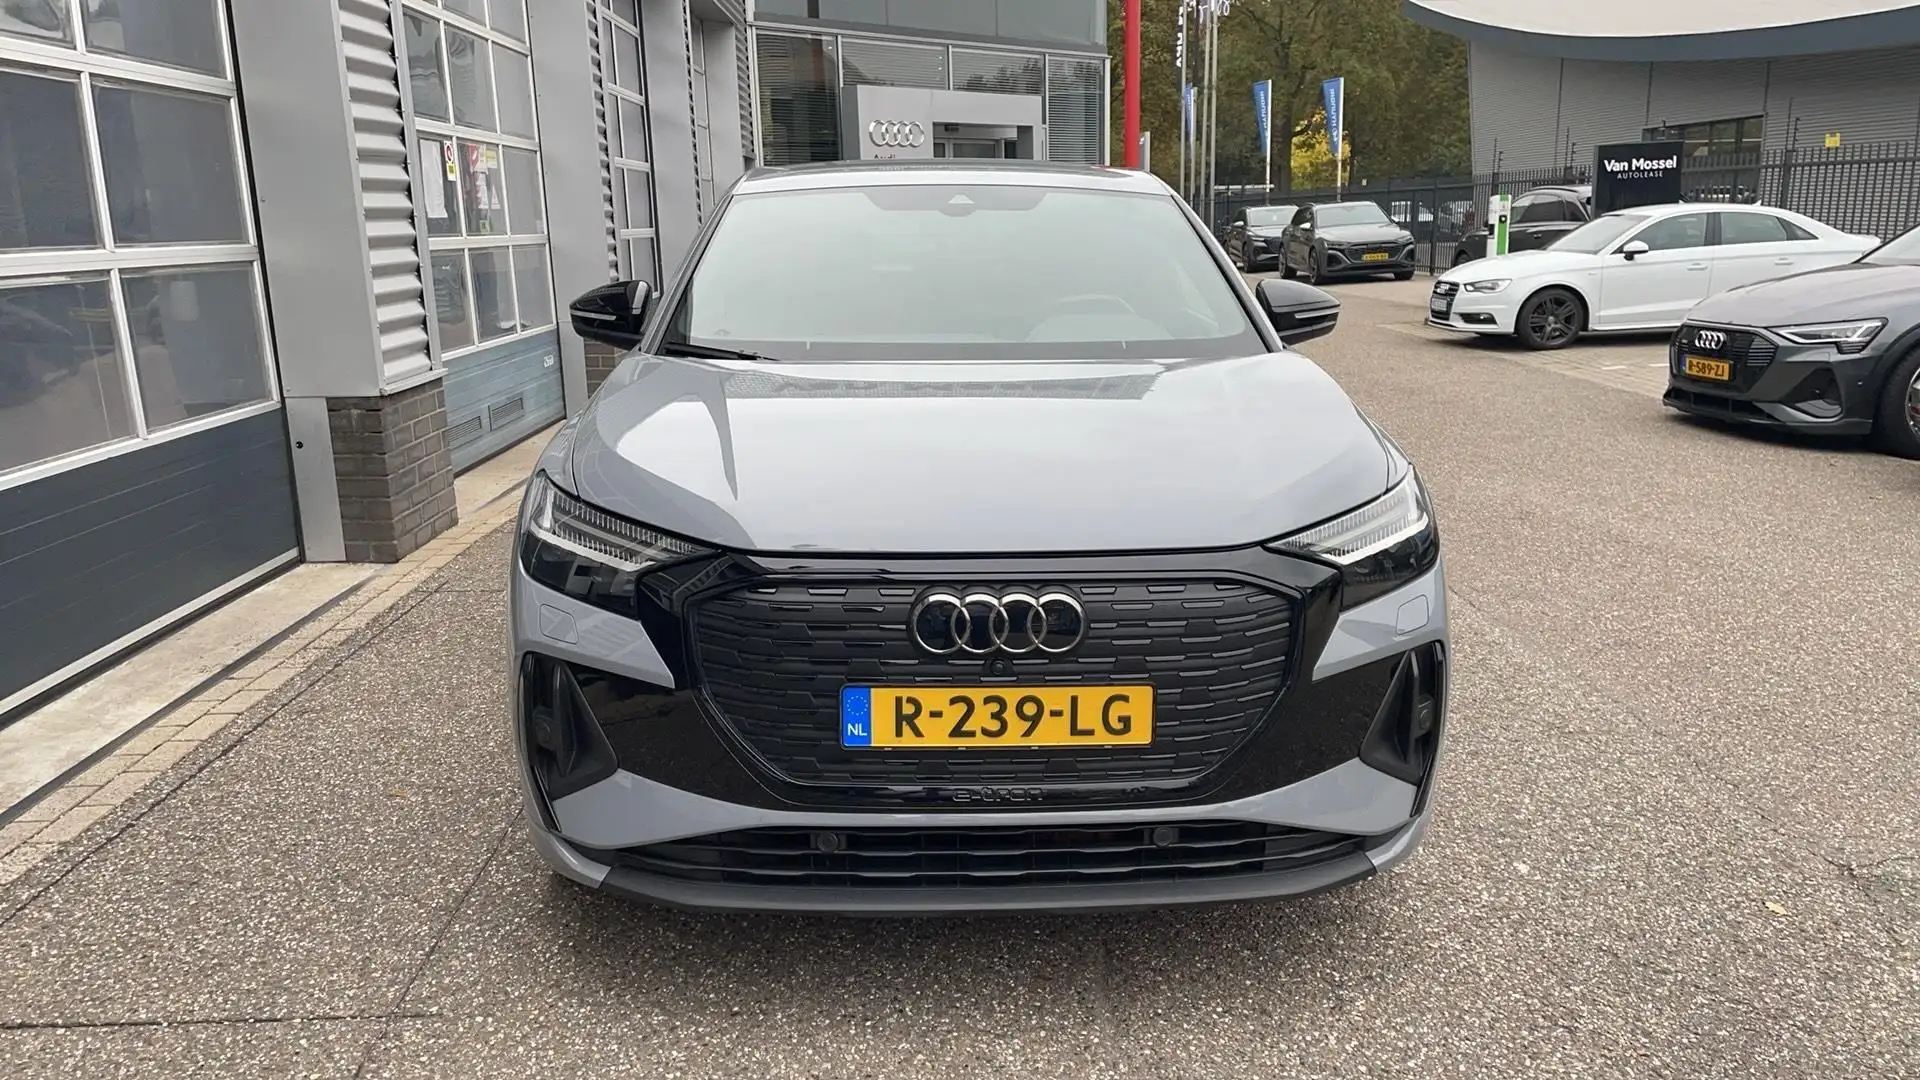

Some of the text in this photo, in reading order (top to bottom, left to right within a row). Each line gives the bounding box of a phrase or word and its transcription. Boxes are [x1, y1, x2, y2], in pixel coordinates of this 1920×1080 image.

[1604, 155, 1678, 172] Van Mossel
[1616, 170, 1664, 179] AUTOLEASE
[894, 693, 1133, 739] R-239-LG
[847, 722, 868, 737] NL
[952, 786, 1044, 802] e-tron
